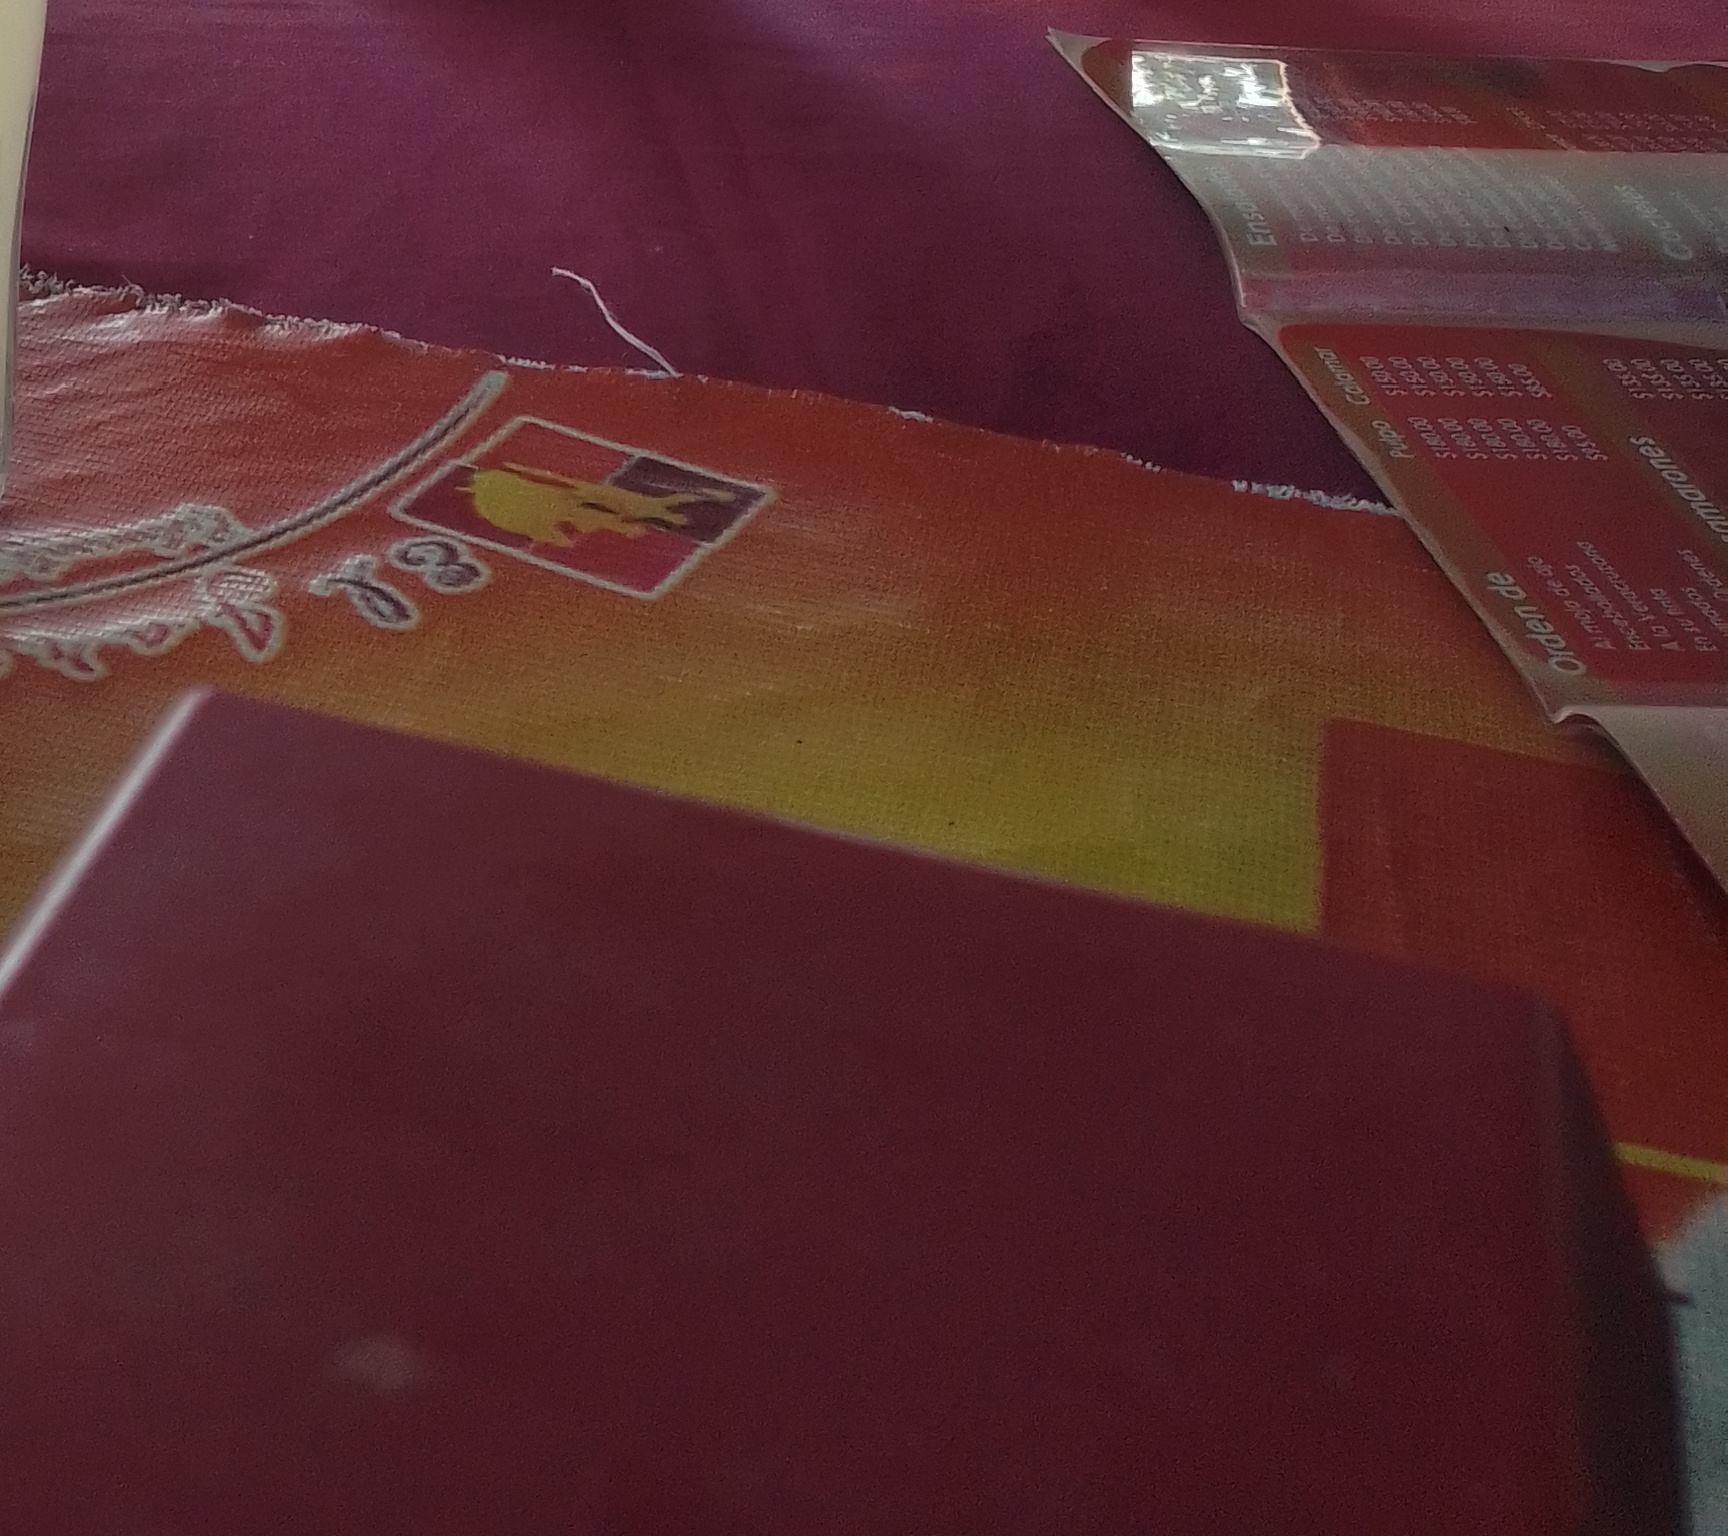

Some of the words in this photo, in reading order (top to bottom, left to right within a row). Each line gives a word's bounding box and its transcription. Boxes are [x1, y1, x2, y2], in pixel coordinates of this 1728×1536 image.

[1314, 346, 1372, 405] Calamar
[1371, 420, 1415, 458] Pulpo
[1486, 571, 1528, 600] de
[1513, 606, 1587, 676] Orden
